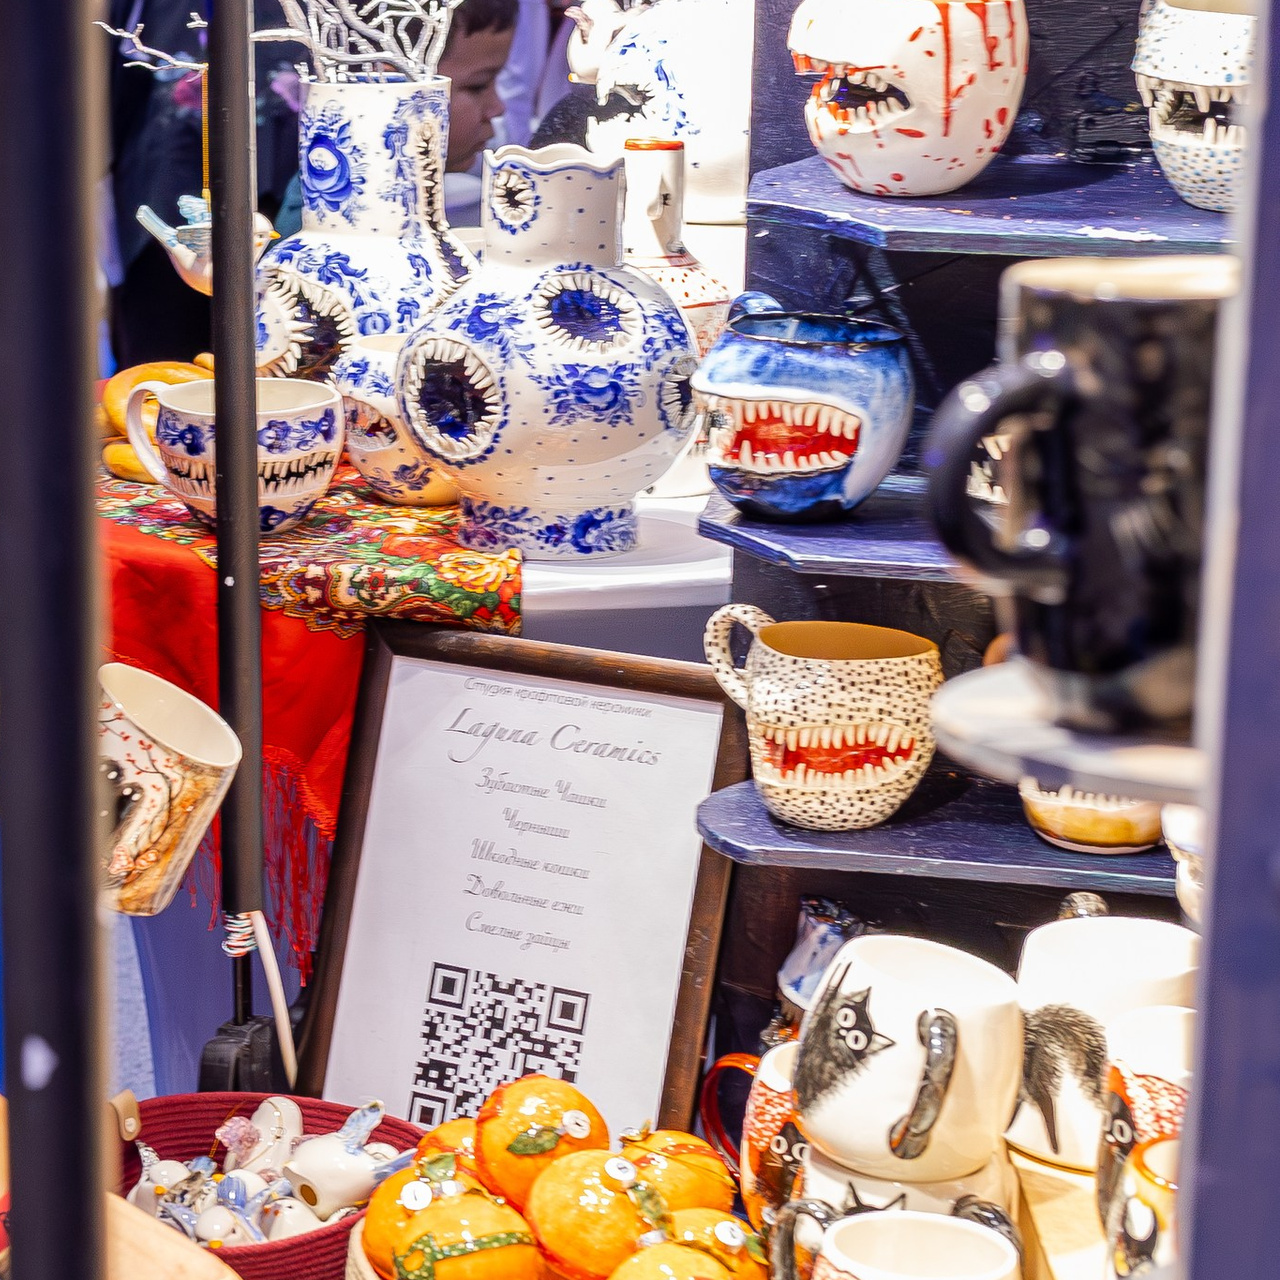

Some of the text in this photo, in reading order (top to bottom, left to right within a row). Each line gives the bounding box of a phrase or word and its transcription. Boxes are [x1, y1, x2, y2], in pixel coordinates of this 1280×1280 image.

[444, 707, 662, 766] Laguna Ceramics
[474, 766, 608, 809] Зубастые Чашки
[470, 837, 591, 879] Шкодные кошки
[462, 873, 550, 908] Довольные
[465, 910, 572, 953] Смелые зайцы
